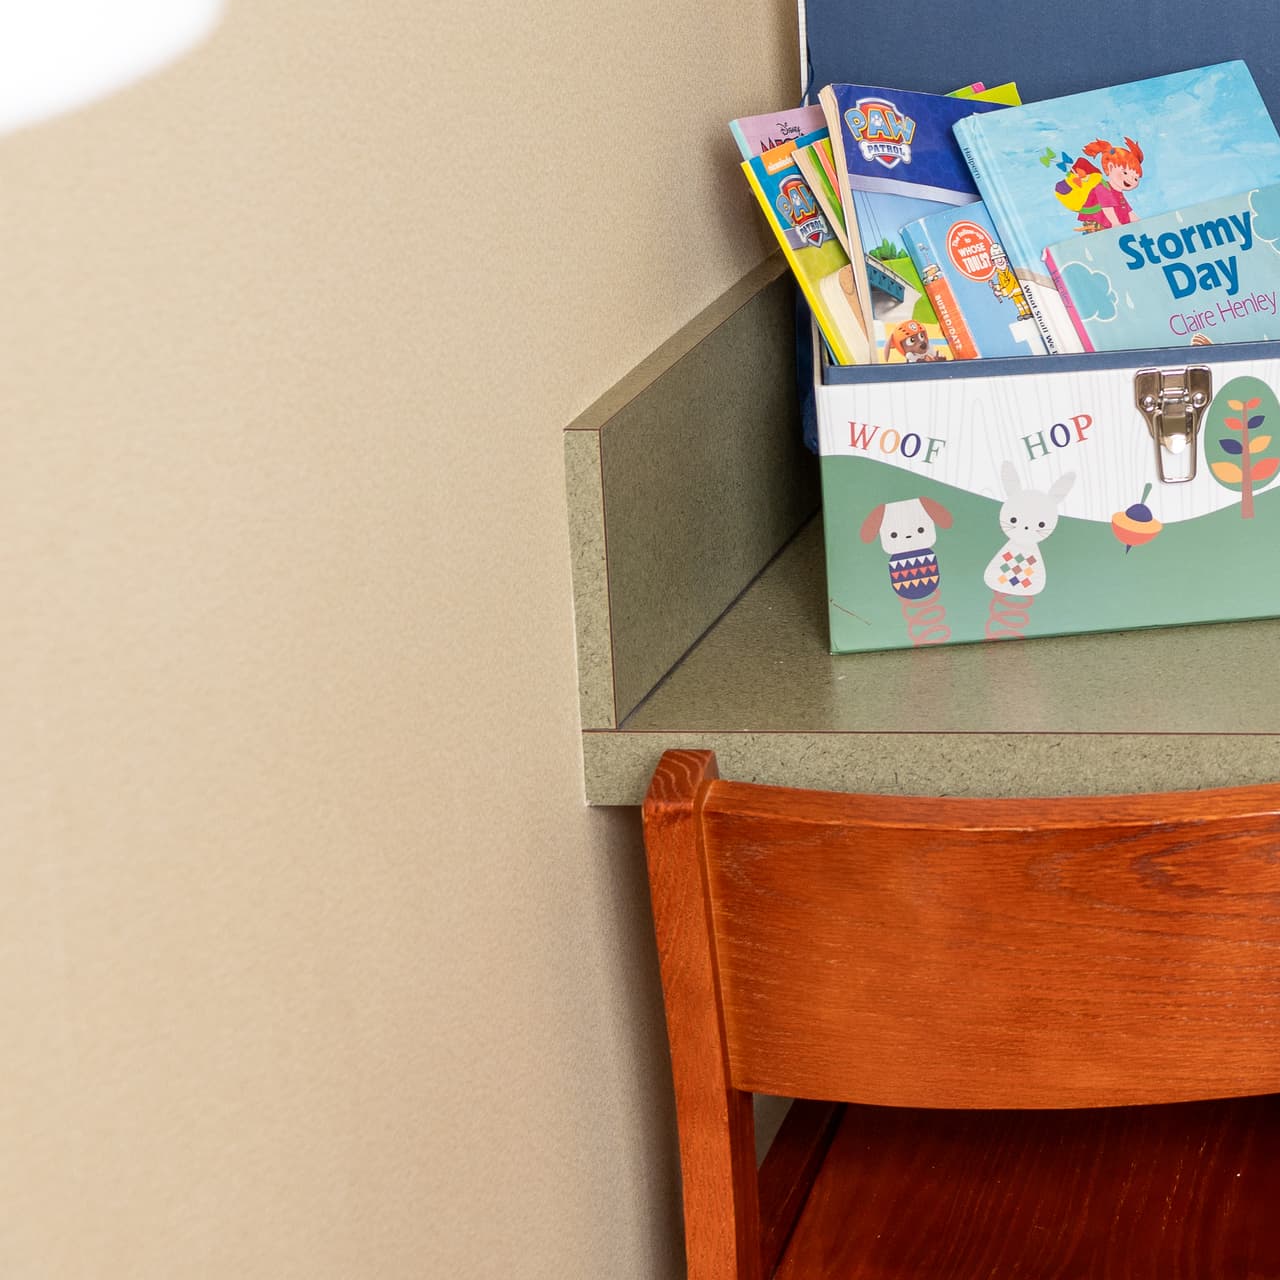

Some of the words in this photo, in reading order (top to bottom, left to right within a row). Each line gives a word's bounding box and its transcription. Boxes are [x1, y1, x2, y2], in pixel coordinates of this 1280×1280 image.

[844, 108, 916, 144] PAW
[867, 144, 905, 156] PATROL
[957, 242, 987, 257] WHOSE
[1118, 210, 1253, 271] Stormy
[1162, 255, 1239, 300] Day
[1023, 284, 1038, 310] What
[1034, 309, 1049, 333] Shall
[1045, 334, 1056, 349] We
[1169, 310, 1217, 336] Claire
[1216, 291, 1277, 323] Henley
[848, 421, 947, 464] WOOF
[1021, 413, 1094, 461] HOP
